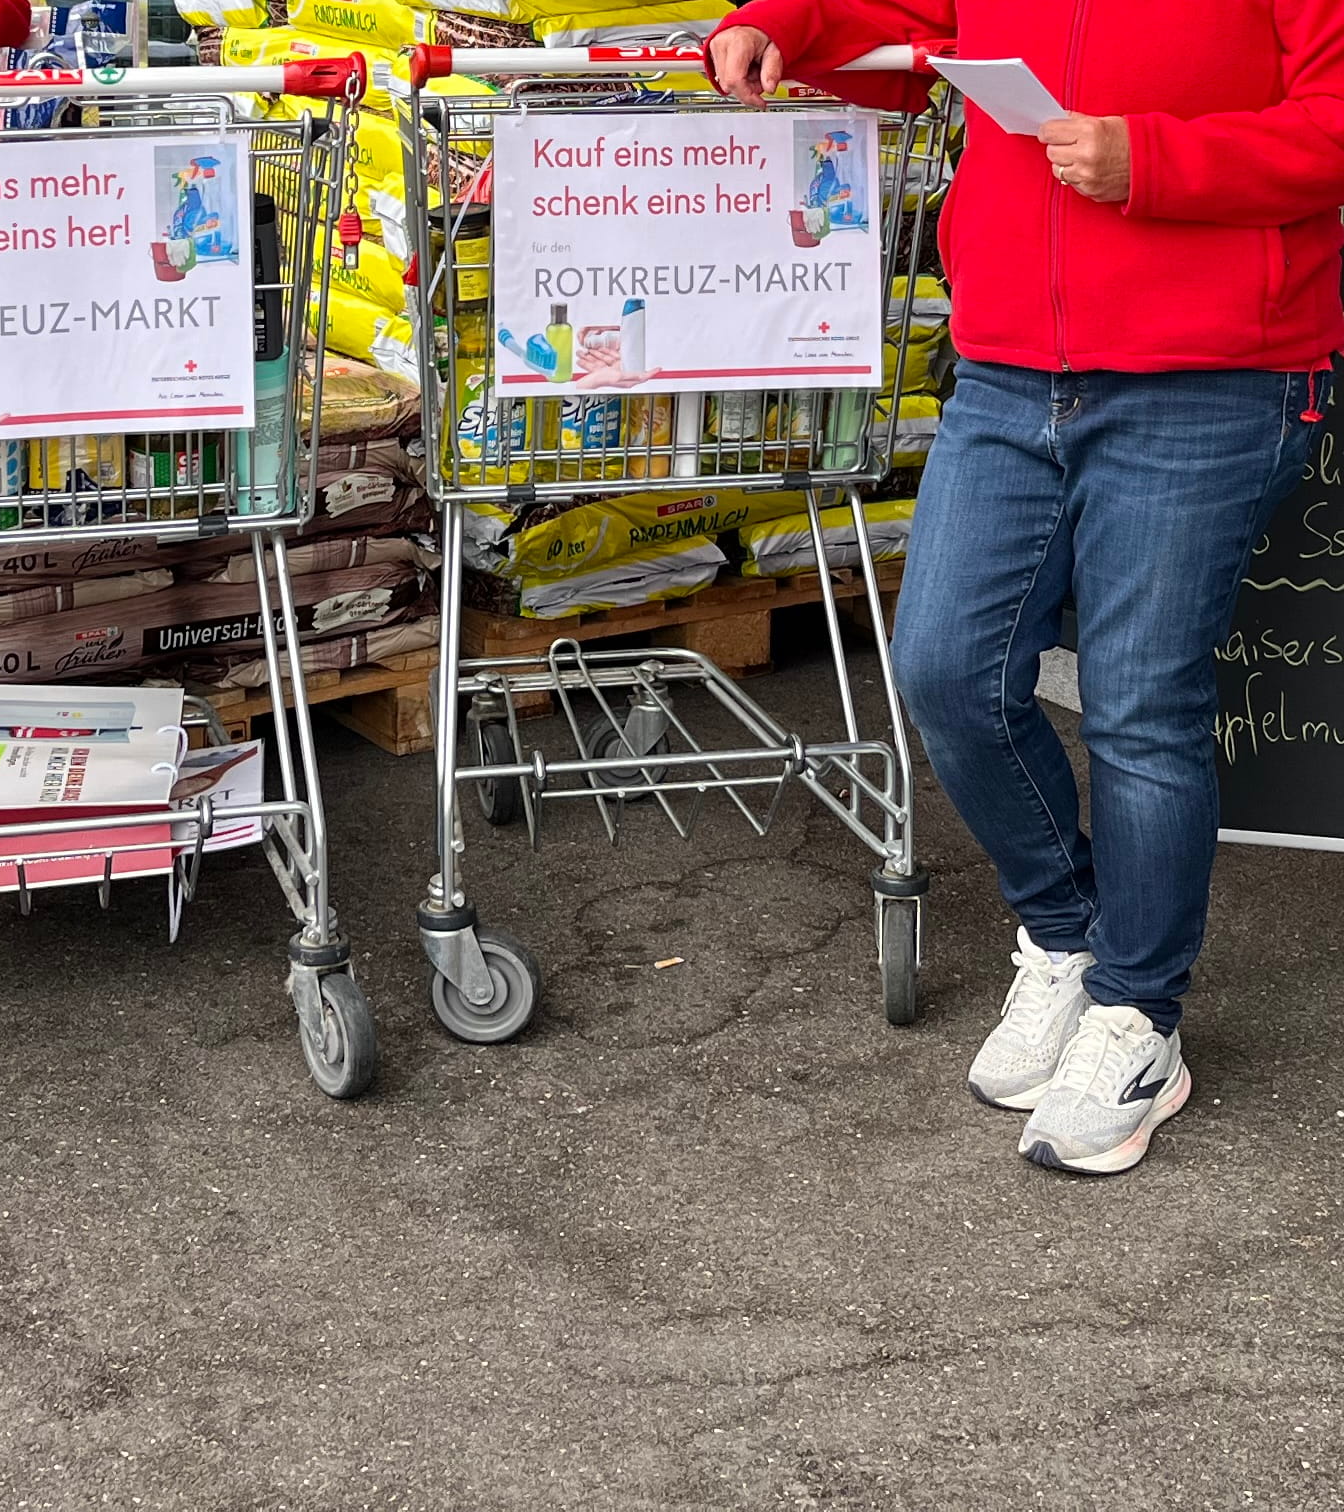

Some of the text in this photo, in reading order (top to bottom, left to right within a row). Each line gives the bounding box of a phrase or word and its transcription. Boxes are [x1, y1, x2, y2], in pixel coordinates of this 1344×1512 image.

[314, 4, 378, 32] RINDENMULCH
[533, 134, 769, 171] Kauf eins mehr,
[29, 163, 126, 202] mehr,
[531, 182, 773, 217] schenk eins her!
[67, 213, 132, 249] her!
[531, 241, 572, 253] für den
[533, 262, 853, 299] ROTKREUZ-MARKT
[666, 501, 703, 515] SPAR
[3, 551, 58, 574] 40 L
[547, 539, 563, 561] 60
[27, 650, 41, 672] L
[55, 645, 128, 676] früher
